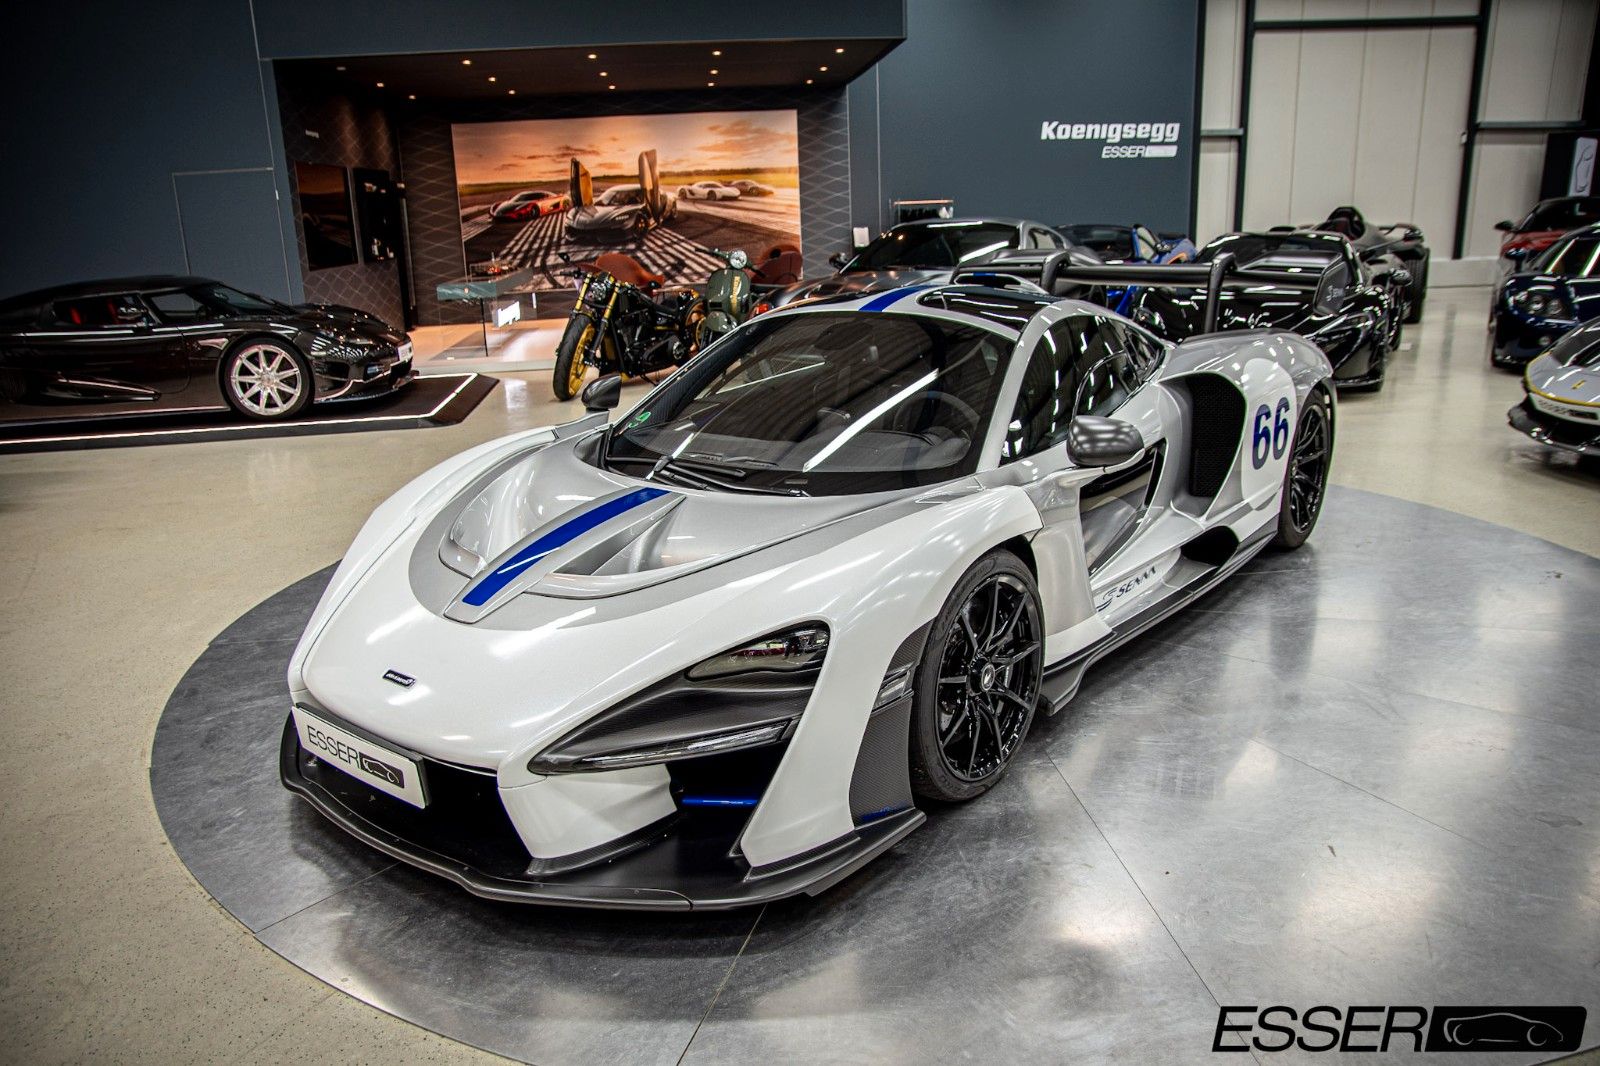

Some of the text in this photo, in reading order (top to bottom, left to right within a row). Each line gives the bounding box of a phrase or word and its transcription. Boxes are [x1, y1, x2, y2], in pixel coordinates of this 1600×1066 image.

[1040, 121, 1180, 143] Koenigsegg
[1101, 145, 1146, 158] ESSER
[1252, 397, 1290, 470] 66
[307, 725, 360, 769] ESSER
